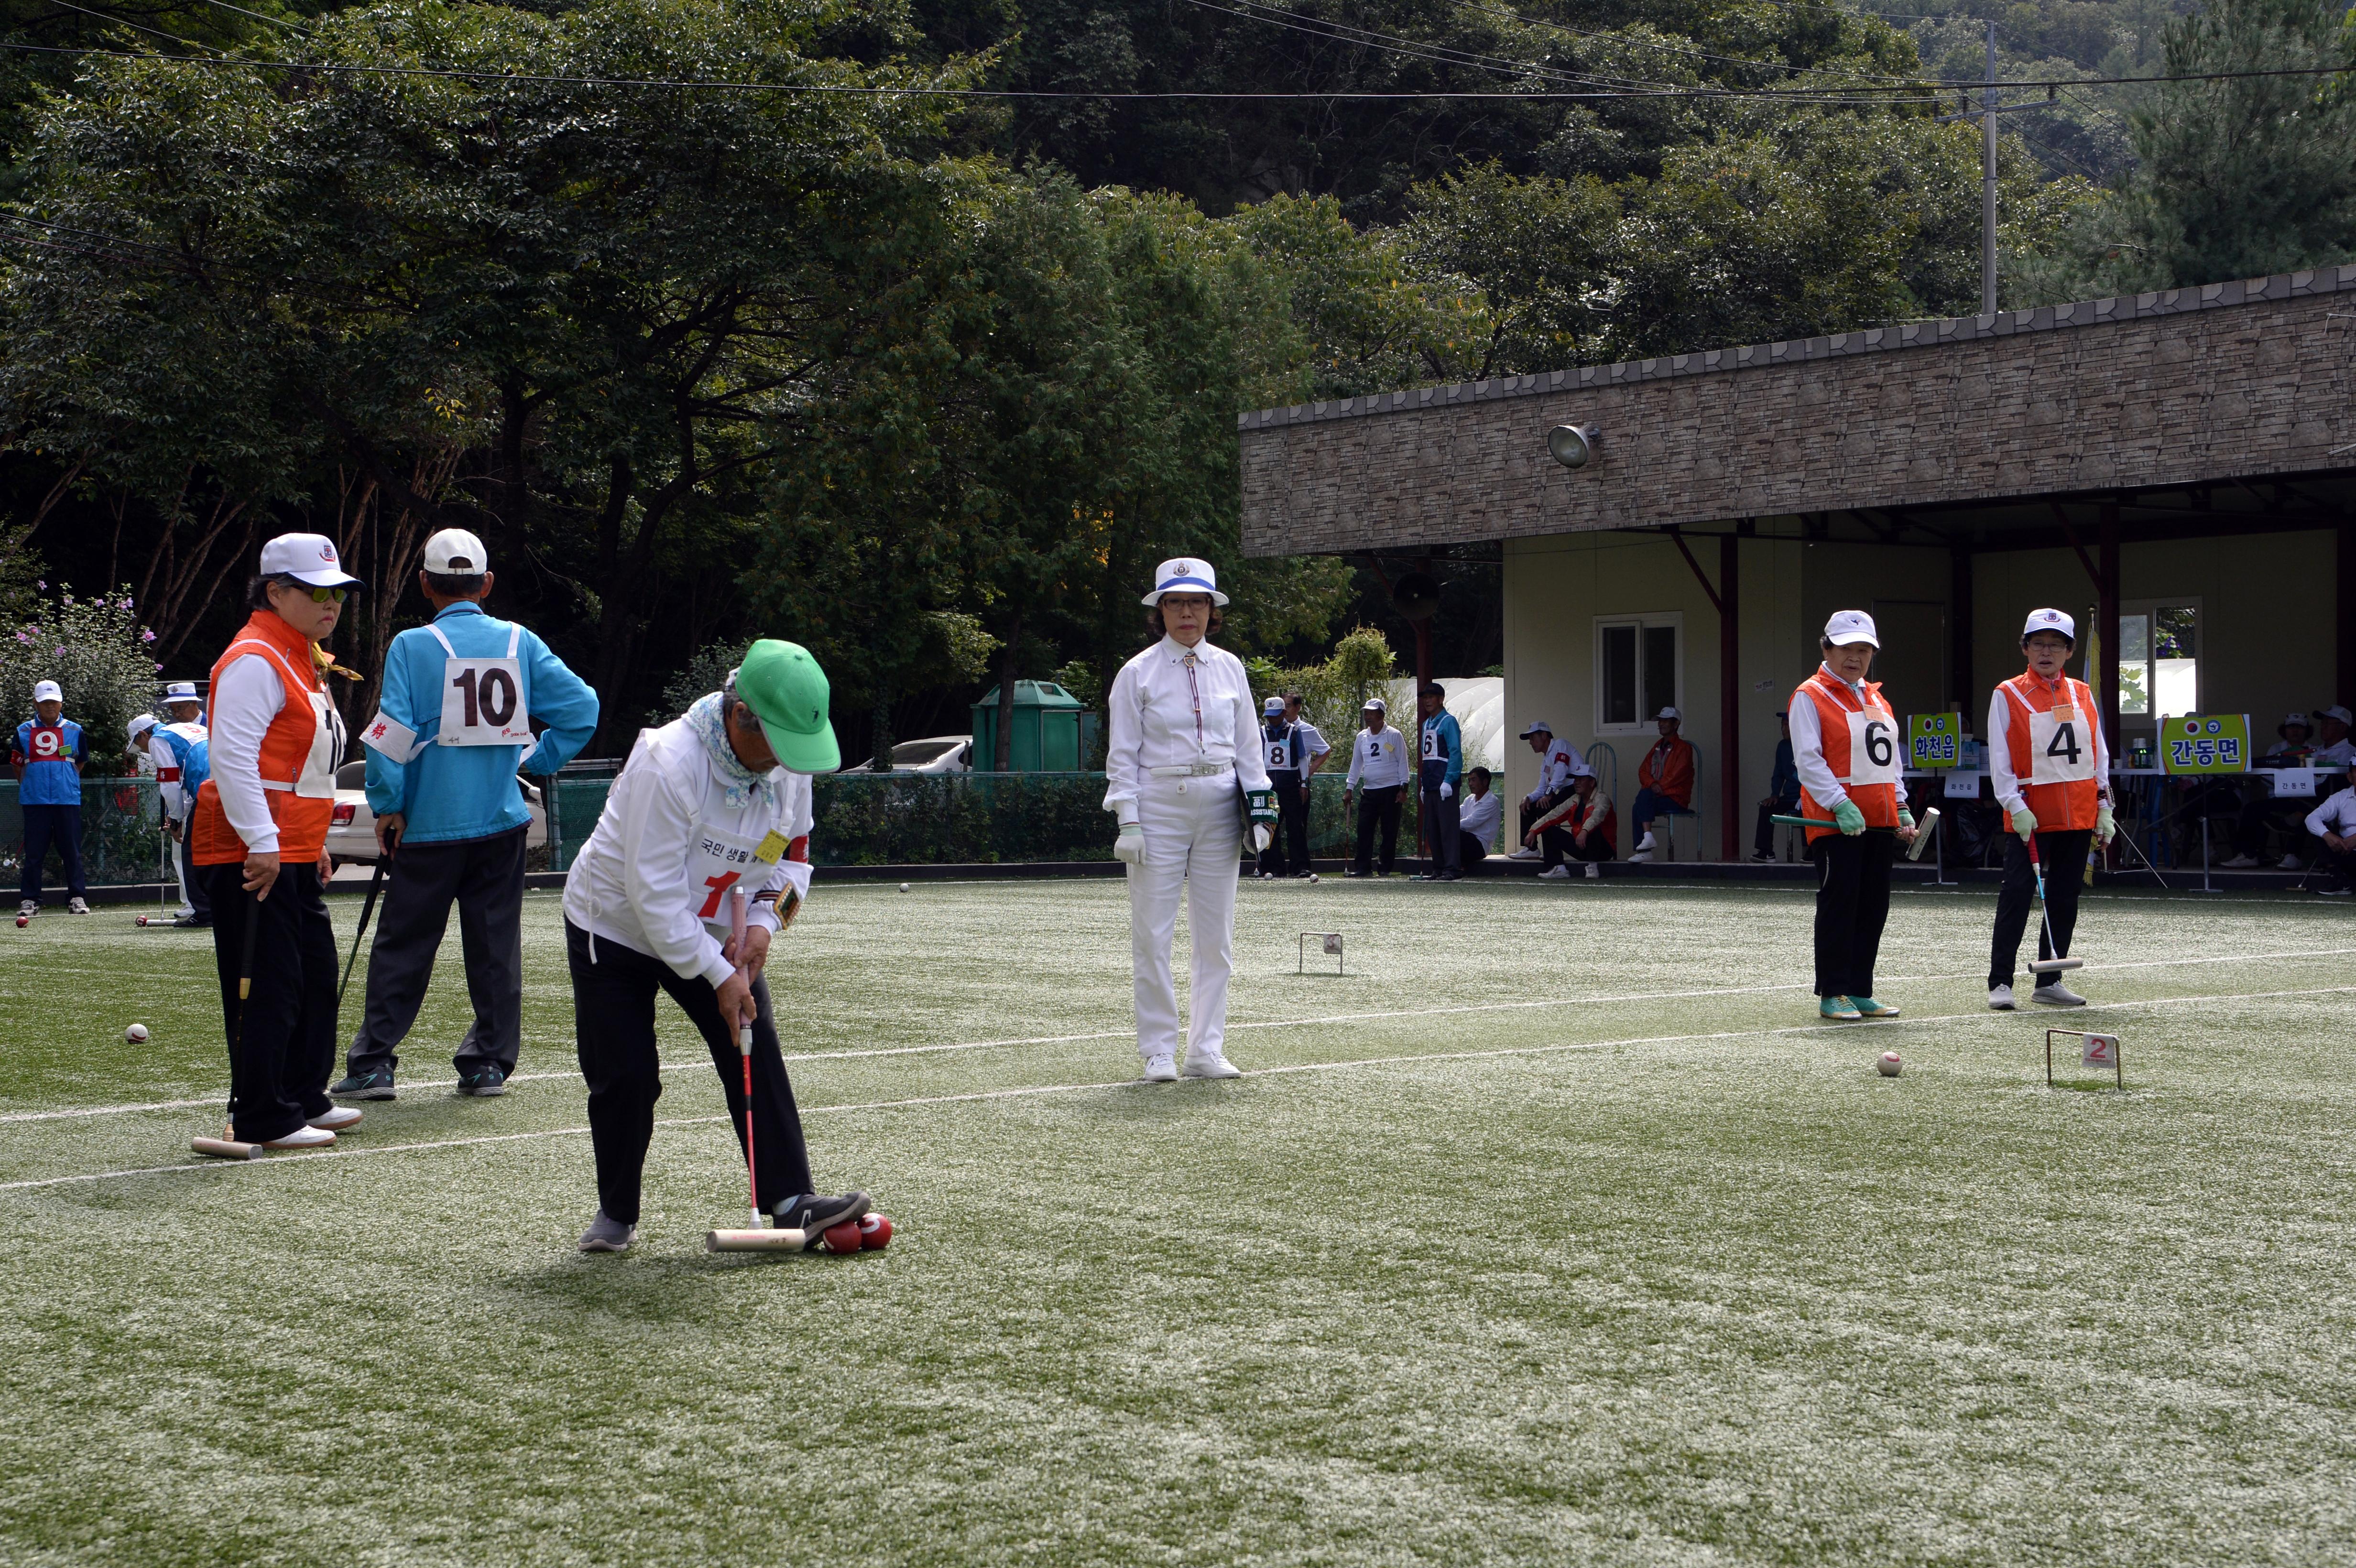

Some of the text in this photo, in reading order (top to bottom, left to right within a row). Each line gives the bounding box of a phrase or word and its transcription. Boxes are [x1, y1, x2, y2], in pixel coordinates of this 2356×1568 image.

[453, 668, 517, 727] 10
[35, 731, 58, 756] 9
[1270, 746, 1285, 765] 8
[1370, 742, 1380, 757] 2
[1424, 735, 1432, 755] 6
[1865, 722, 1892, 767] 6
[1915, 734, 1955, 760] 화천읍
[2047, 722, 2082, 764] 4
[2171, 739, 2239, 765] 간동면
[1253, 795, 1265, 807] 副
[701, 838, 725, 857] 국민
[726, 848, 749, 863] 생활
[697, 871, 742, 918] 1
[2090, 1038, 2106, 1058] 2
